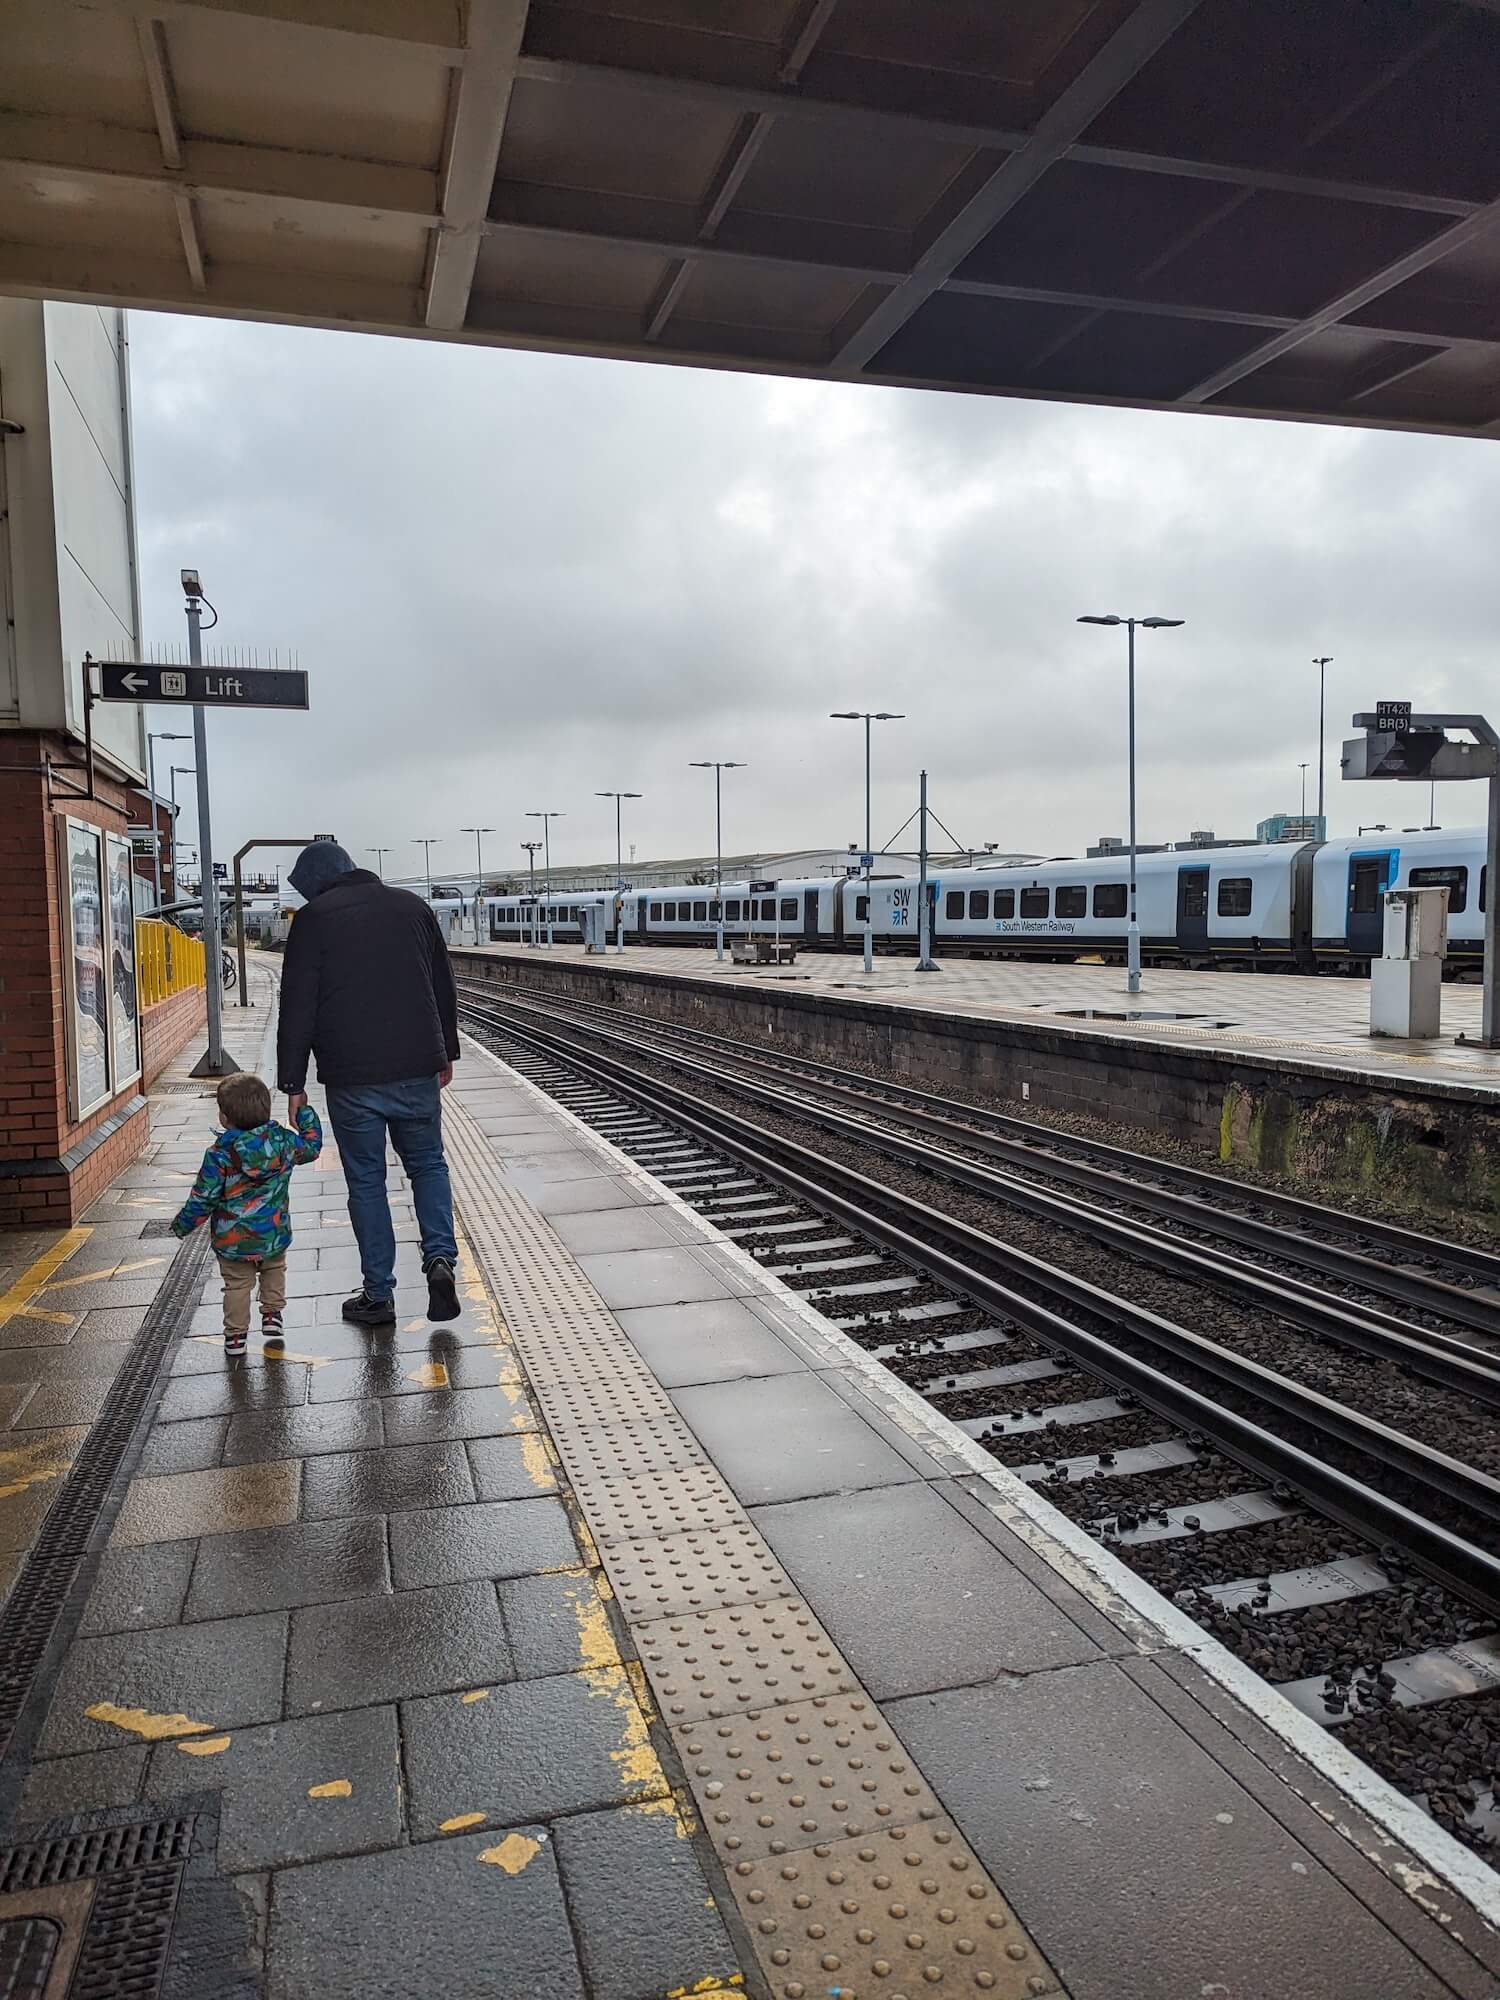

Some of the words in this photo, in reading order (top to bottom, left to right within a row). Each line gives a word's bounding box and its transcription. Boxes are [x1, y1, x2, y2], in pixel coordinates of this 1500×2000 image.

[205, 676, 243, 697] Lift
[1377, 704, 1410, 715] HT420
[1379, 718, 1408, 731] BR(3)
[893, 888, 911, 907] SW
[901, 907, 909, 926] R
[1002, 920, 1020, 932] South
[1021, 920, 1048, 932] Western
[1048, 920, 1076, 935] Railway
